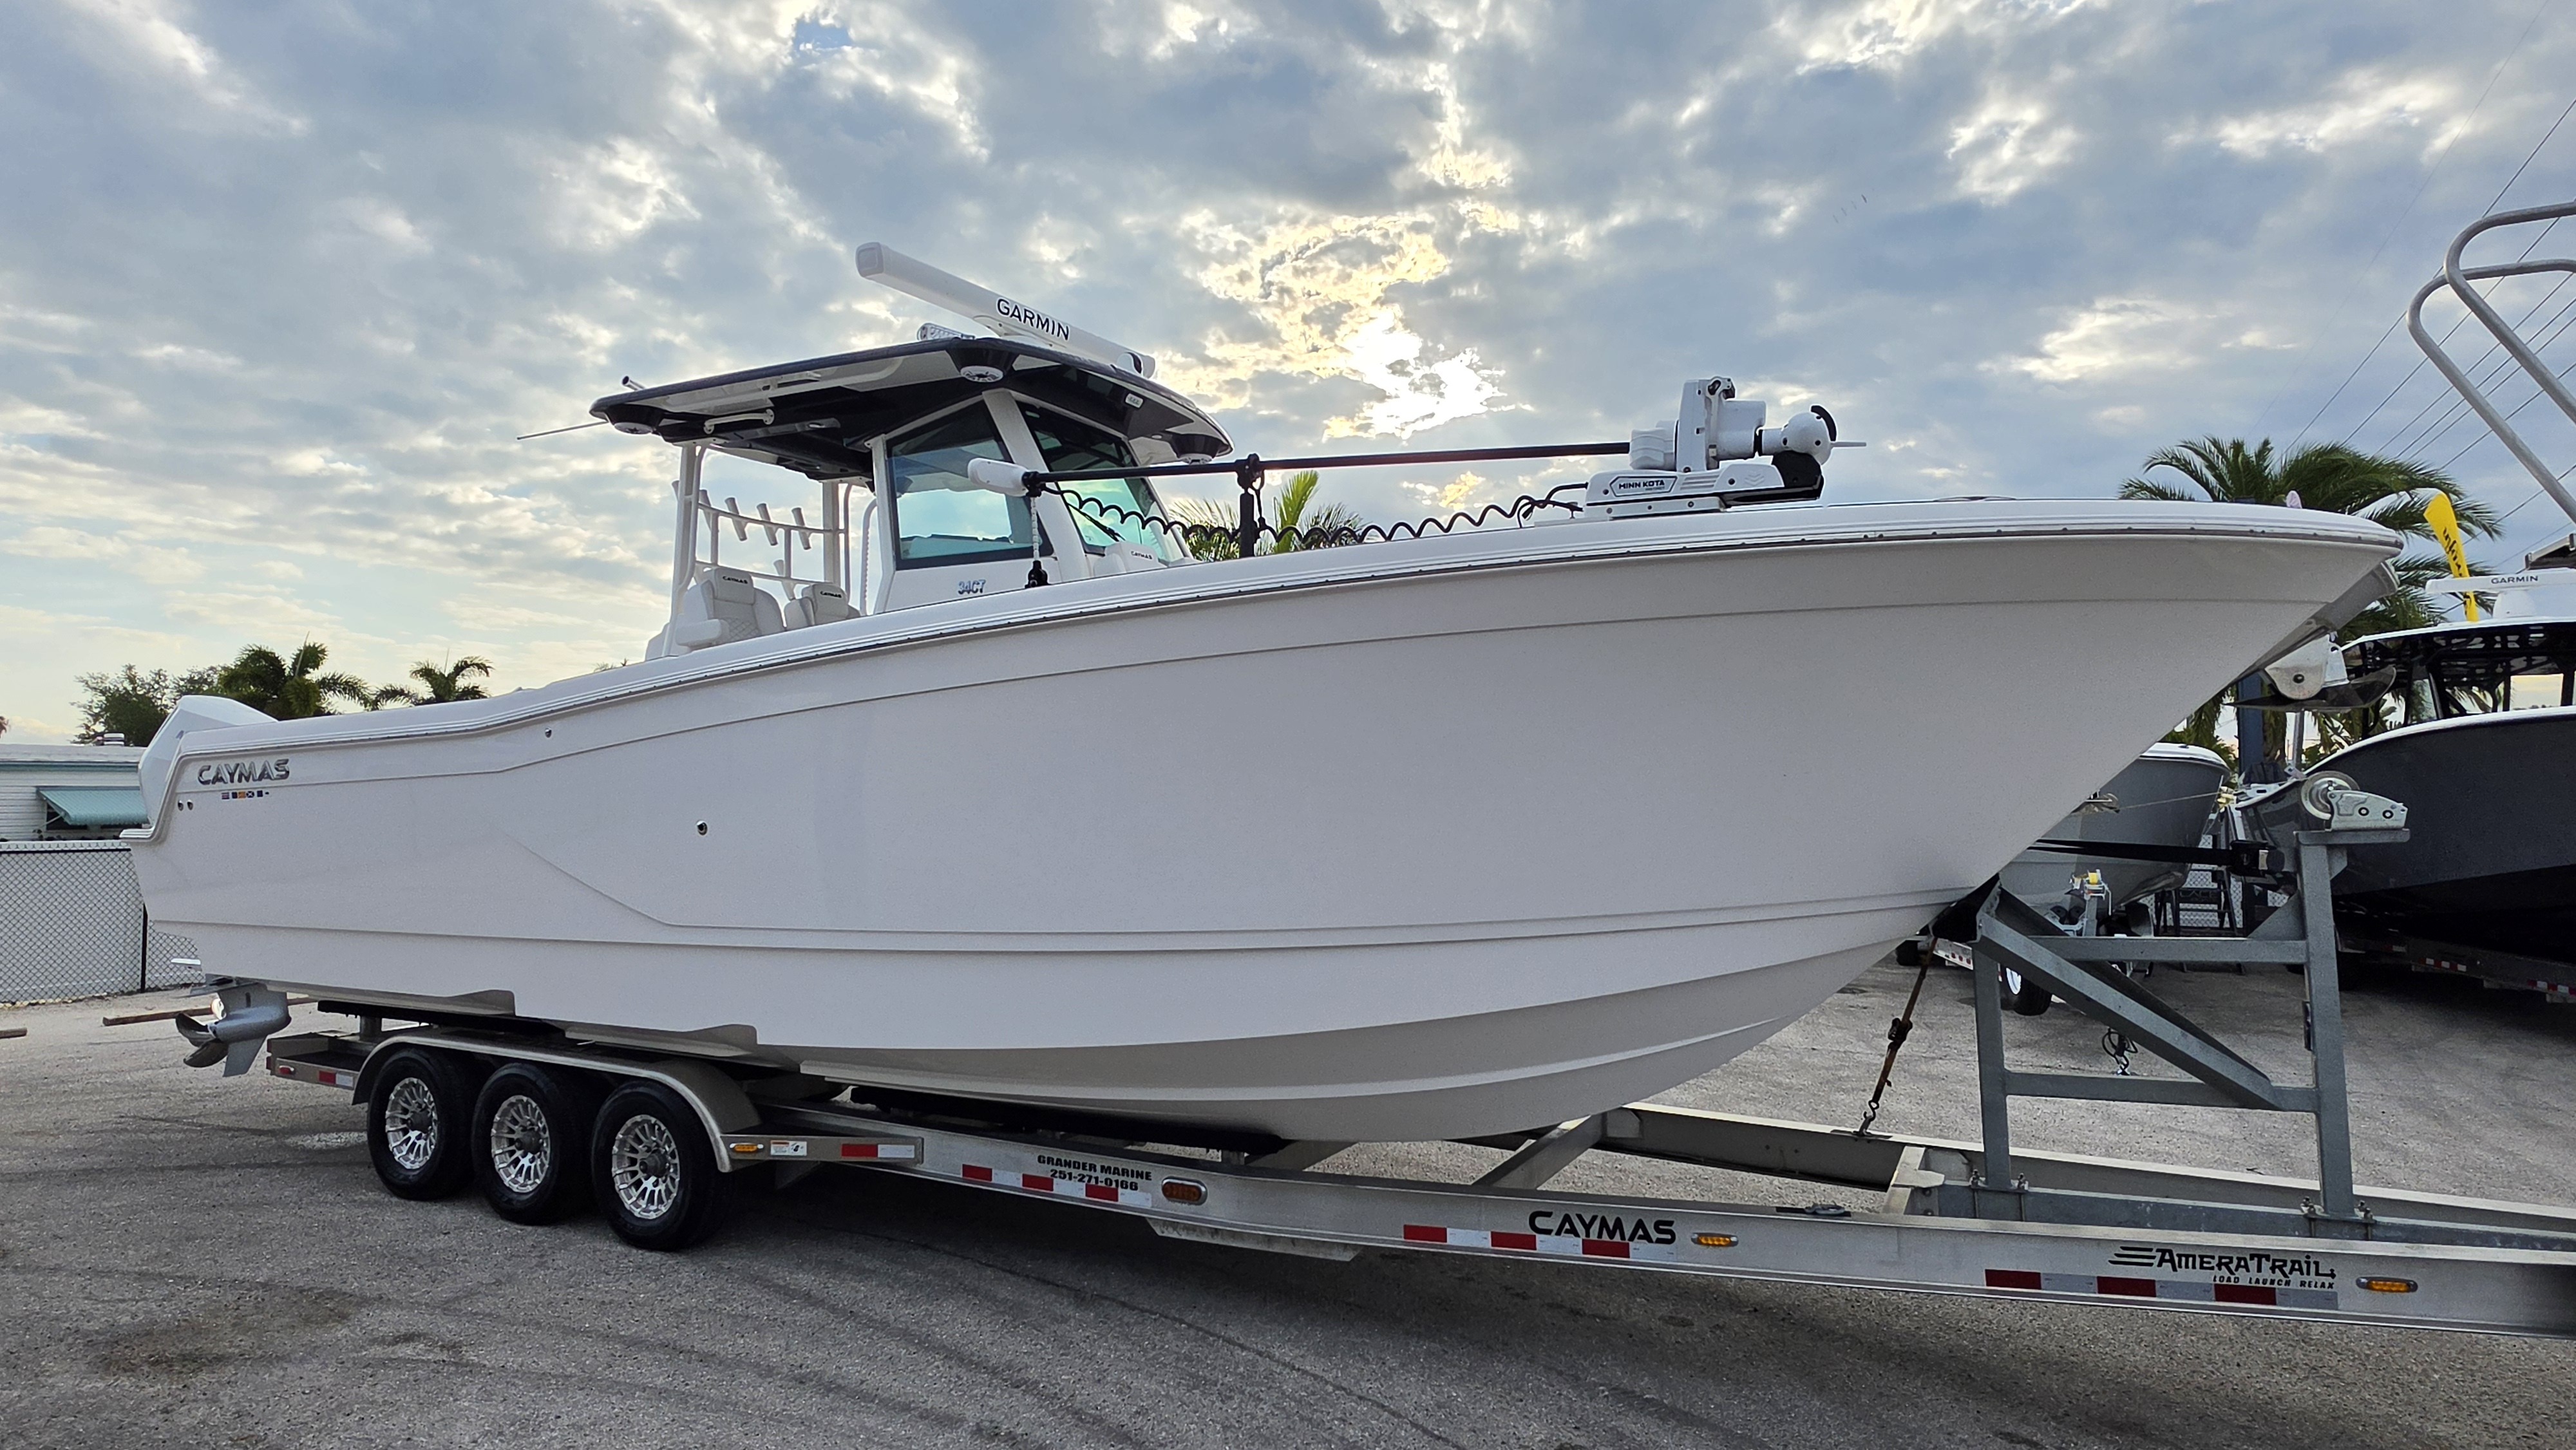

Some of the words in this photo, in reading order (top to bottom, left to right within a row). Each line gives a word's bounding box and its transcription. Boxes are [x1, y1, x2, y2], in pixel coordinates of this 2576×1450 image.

[997, 298, 1069, 341] GARMIN
[1642, 479, 1665, 487] KOTA
[2491, 575, 2539, 584] GARMIN
[198, 758, 290, 786] CAYMAS
[1037, 1155, 1097, 1172] GRANDER
[1100, 1165, 1152, 1180] MARINE
[1050, 1169, 1139, 1191] 251-271-0166
[1528, 1210, 1676, 1245] CAYMAS
[2213, 1275, 2240, 1283] LOAD
[2248, 1277, 2291, 1287] LAUNCH
[2300, 1280, 2334, 1289] RELAX
